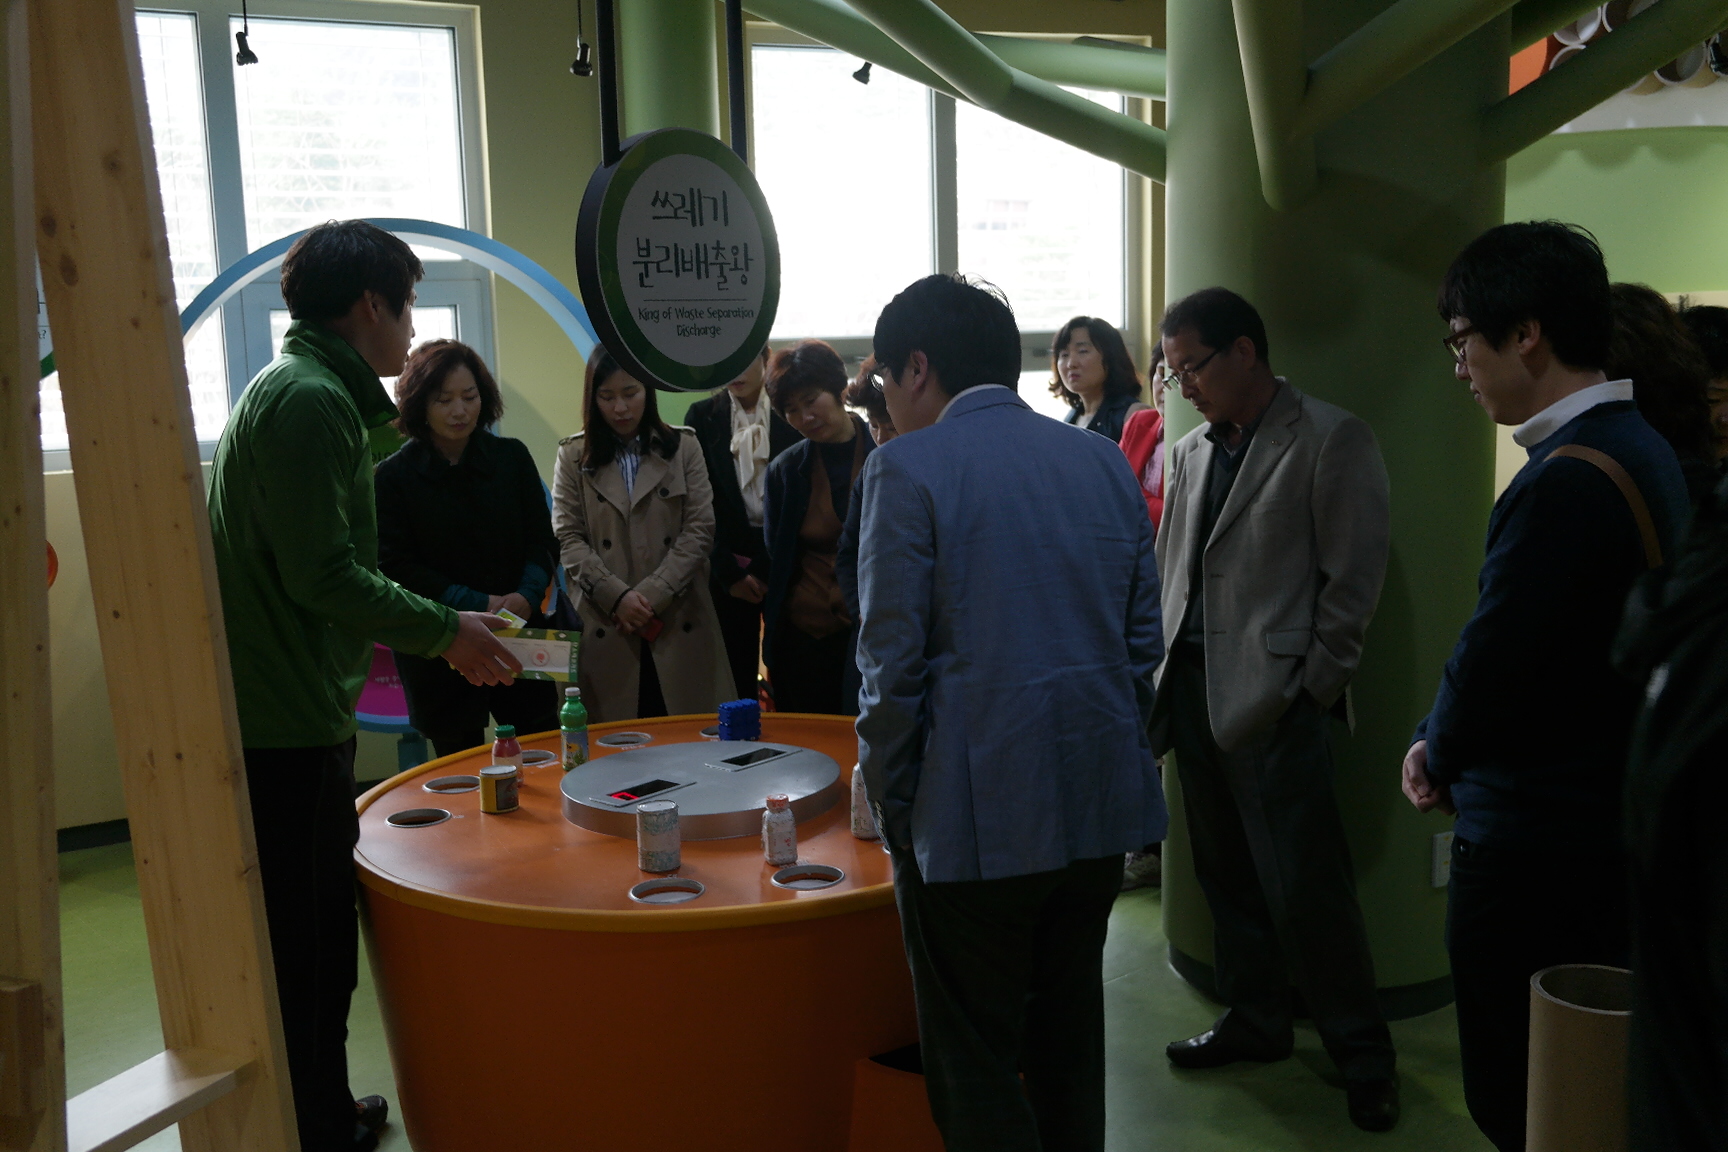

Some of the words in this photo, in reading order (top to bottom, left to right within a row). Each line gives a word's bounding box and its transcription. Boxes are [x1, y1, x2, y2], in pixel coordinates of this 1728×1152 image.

[651, 188, 728, 227] 쓰레기
[633, 237, 754, 291] 분리배출왕
[638, 307, 660, 323] King
[662, 306, 672, 320] of
[675, 307, 704, 320] Waste
[707, 307, 754, 321] Separation
[676, 323, 721, 338] Discharge
